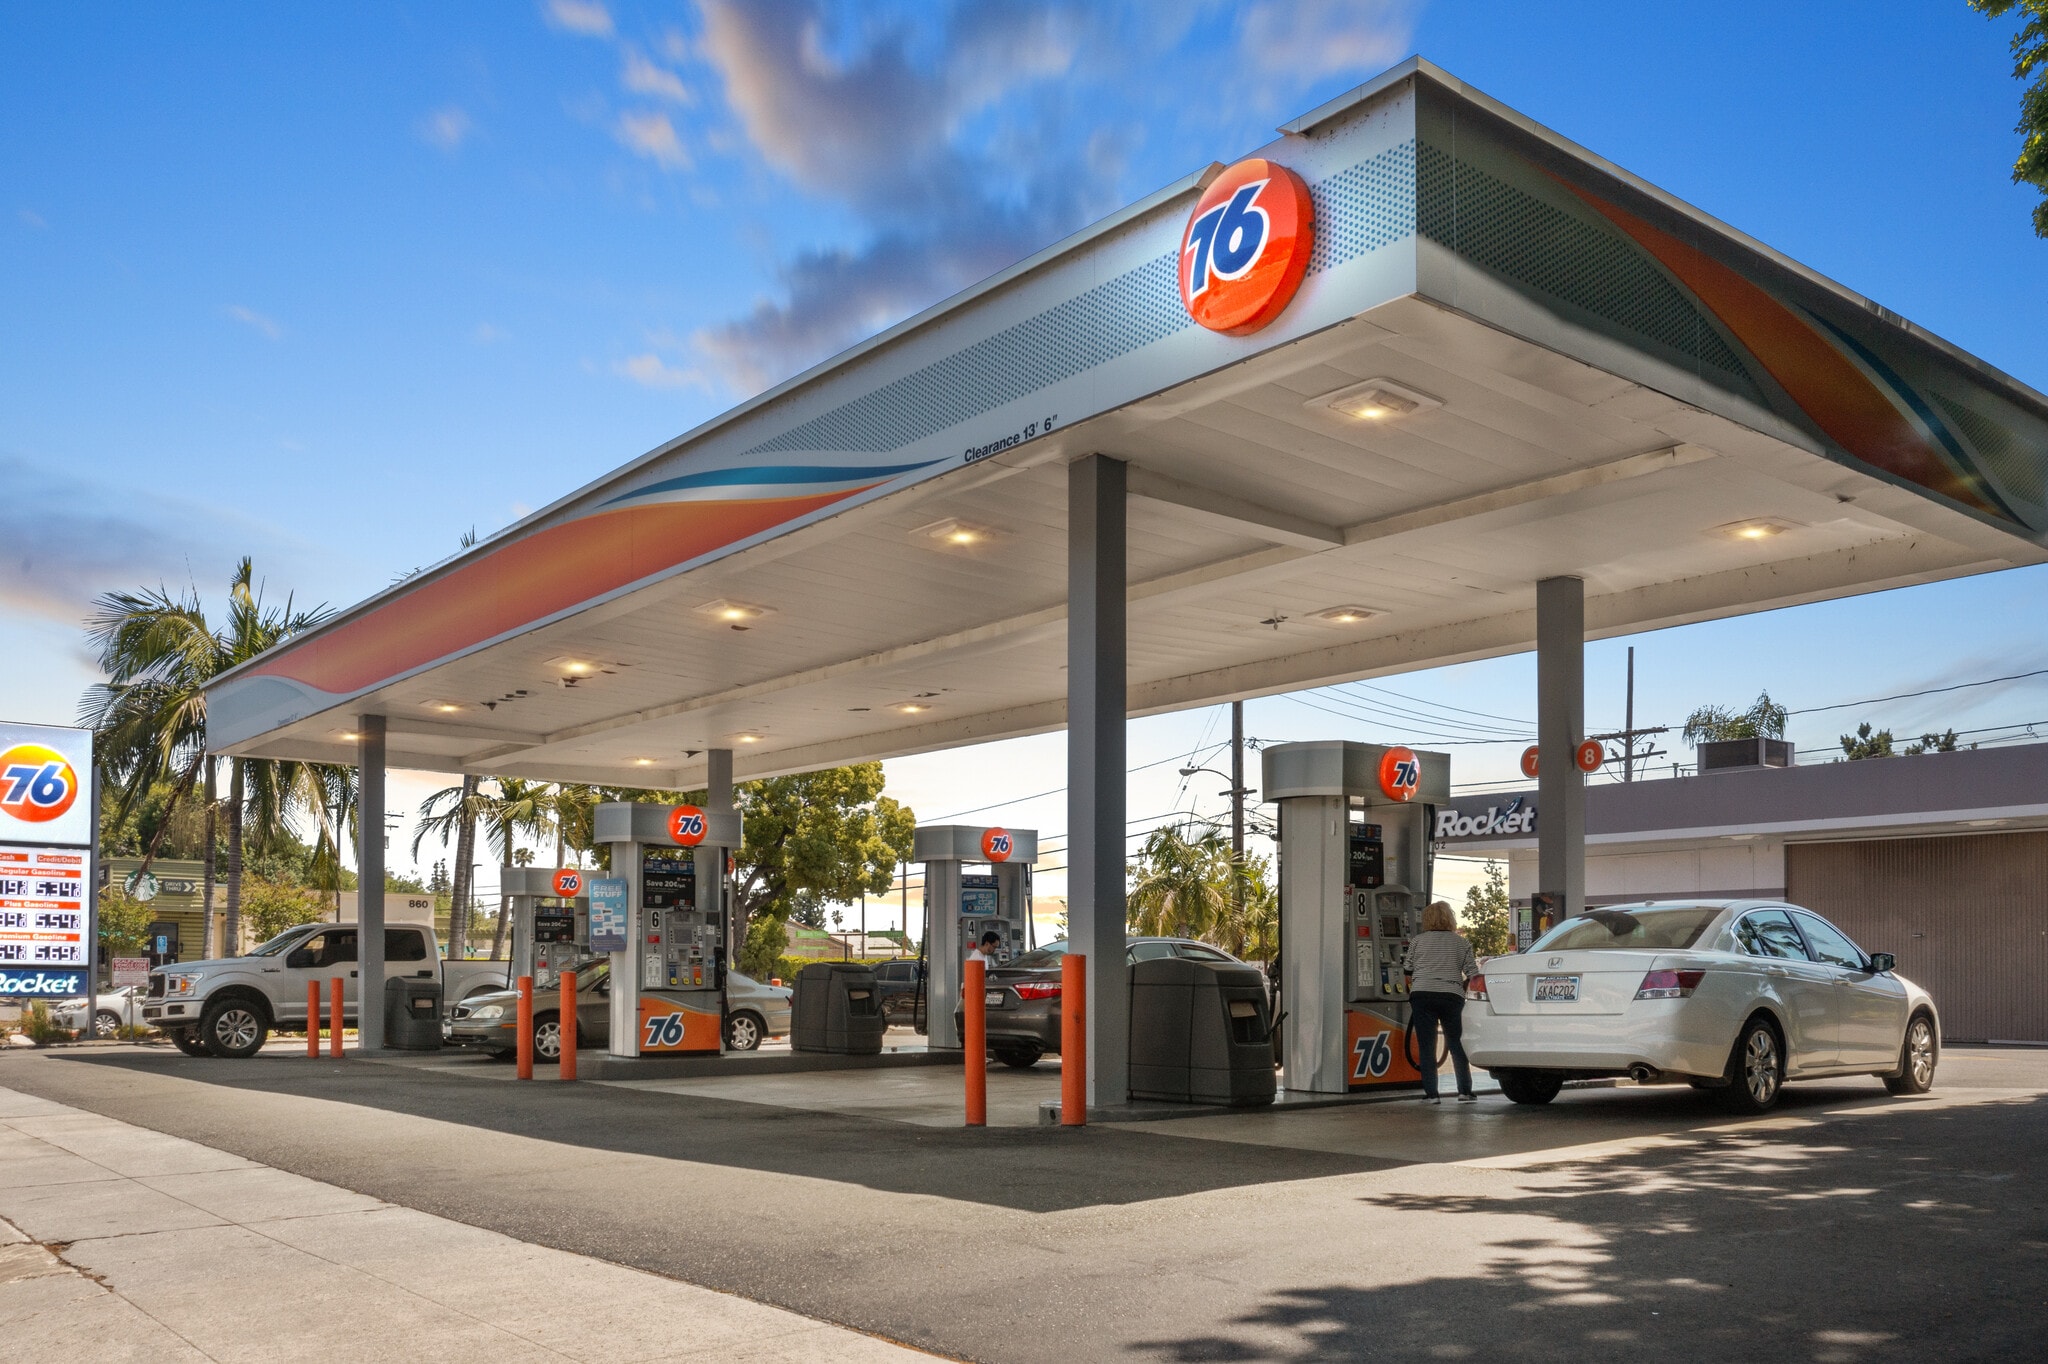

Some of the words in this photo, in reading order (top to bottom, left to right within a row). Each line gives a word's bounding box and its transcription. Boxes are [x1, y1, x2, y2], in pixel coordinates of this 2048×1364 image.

[1185, 178, 1271, 301] 76
[965, 433, 1020, 462] Clearance
[1023, 422, 1038, 439] 13'
[1530, 755, 1538, 769] 7
[1584, 749, 1594, 764] 8
[1392, 759, 1419, 788] 76
[0, 761, 69, 807] 76
[677, 814, 703, 836] 76
[1435, 806, 1535, 837] Rocket
[990, 834, 1009, 853] 76
[38, 855, 81, 864] Credit/Debit
[31, 868, 66, 876] Gasoline
[560, 876, 578, 890] 76
[24, 901, 59, 909] Gasoline
[409, 900, 428, 908] 860
[1358, 893, 1366, 915] 8
[652, 911, 660, 928] 6
[968, 921, 975, 935] 4
[33, 933, 67, 941] Gasoline
[541, 944, 546, 956] 2
[1537, 985, 1575, 997] 6KAC202
[645, 1012, 684, 1046] 76
[1353, 1031, 1392, 1078] 76
